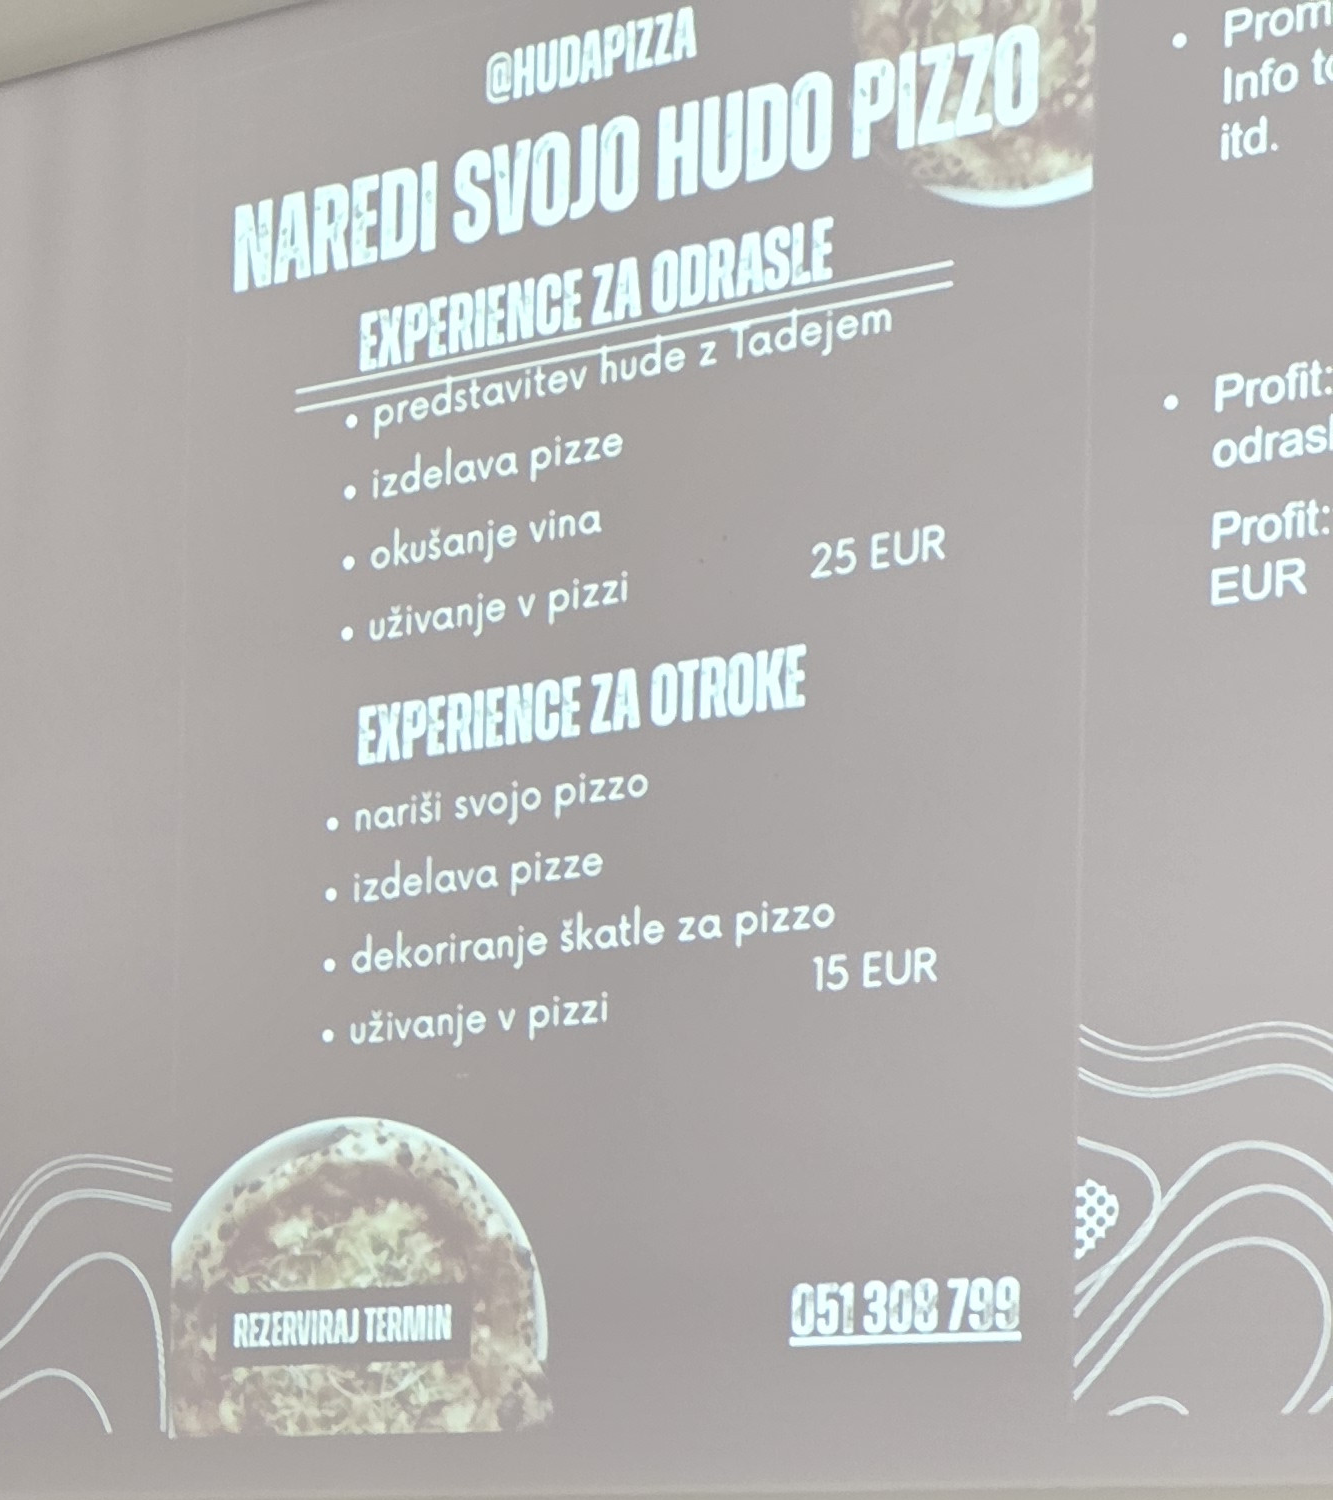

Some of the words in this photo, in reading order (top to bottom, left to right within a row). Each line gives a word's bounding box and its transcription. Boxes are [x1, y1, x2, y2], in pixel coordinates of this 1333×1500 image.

[1224, 0, 1333, 48] Prom
[485, 6, 700, 105] @HUDAPIZZA
[1223, 57, 1299, 105] Info
[232, 159, 439, 295] NAREDI
[452, 114, 641, 245] SVOJO
[657, 71, 834, 202] HUDO
[851, 24, 1042, 158] PIZZO
[1219, 116, 1279, 161] itd.
[359, 269, 585, 374] EXPERIENCE
[591, 257, 644, 321] ZA
[651, 216, 836, 316] ODRASLE
[372, 364, 587, 438] predstavitev
[599, 333, 685, 384] hude
[699, 339, 717, 367] z
[731, 304, 893, 361] Tadejem
[1214, 359, 1333, 413] Profit:
[372, 446, 520, 501] izdelava
[529, 431, 625, 483] pizze
[369, 520, 518, 571] okušanje
[528, 509, 603, 544] vina
[810, 537, 858, 580] 25
[870, 523, 947, 572] EUR
[1211, 499, 1331, 551] Profit:
[369, 596, 507, 641] uživanje
[517, 593, 536, 618] v
[548, 571, 629, 625] pizzi
[1210, 557, 1307, 606] EUR
[357, 675, 582, 766] EXPERIENCE
[590, 668, 641, 735] ZA
[650, 643, 808, 728] OTROKE
[354, 790, 442, 832] nariši
[454, 780, 542, 826] svojo
[554, 773, 649, 819] pizzo
[353, 856, 500, 903] izdelava
[510, 851, 604, 896] pizze
[351, 924, 549, 974] dekoriranje
[560, 905, 665, 953] škatle
[677, 913, 723, 943] za
[735, 901, 836, 947] pizzo
[813, 954, 850, 992] 15
[862, 947, 938, 988] EUR
[349, 1004, 487, 1048] uživanje
[497, 1007, 516, 1032] v
[528, 991, 609, 1040] pizzi
[233, 1307, 360, 1349] REZERVIRAJ
[364, 1303, 452, 1344] TERMIN
[791, 1281, 855, 1336] 051
[862, 1277, 939, 1334] 308
[947, 1275, 1021, 1332] 799
